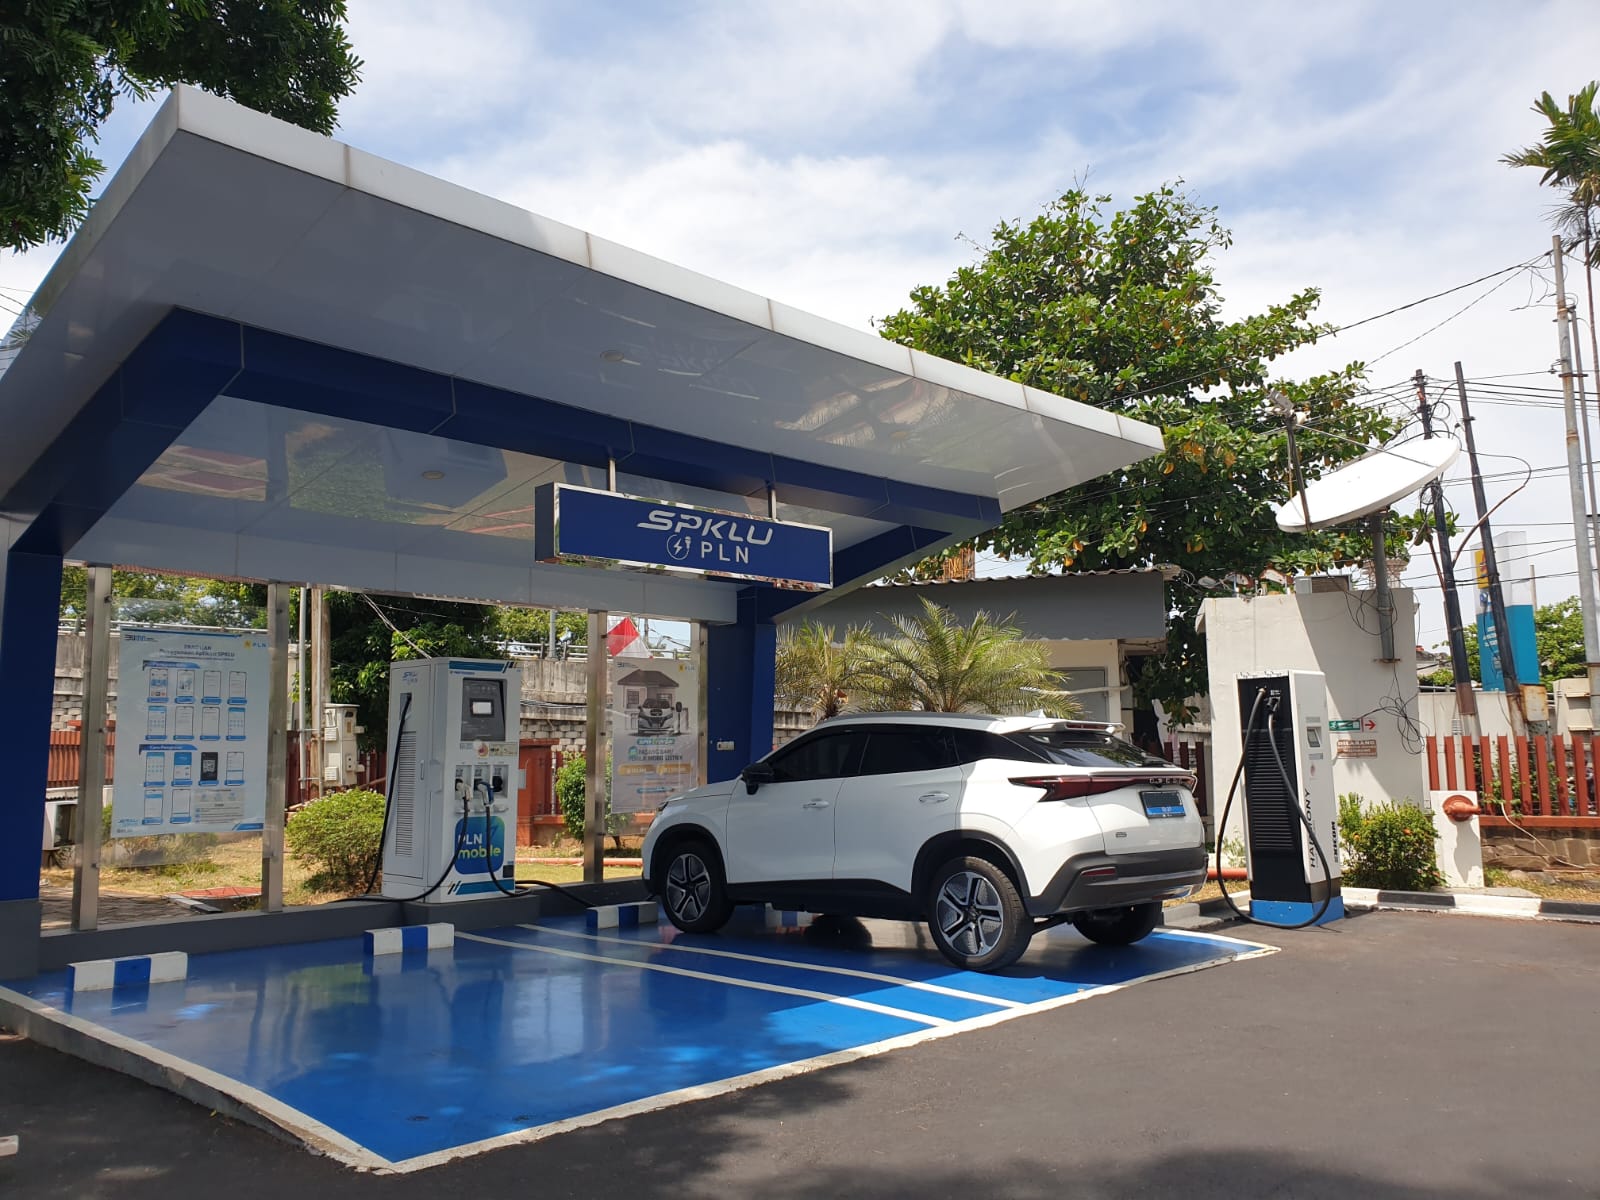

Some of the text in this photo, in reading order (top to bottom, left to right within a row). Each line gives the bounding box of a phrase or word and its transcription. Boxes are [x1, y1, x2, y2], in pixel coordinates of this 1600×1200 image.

[637, 509, 773, 545] SPKLU
[701, 541, 749, 564] PLN
[1304, 787, 1316, 868] HAONY
[457, 844, 501, 860] moble
